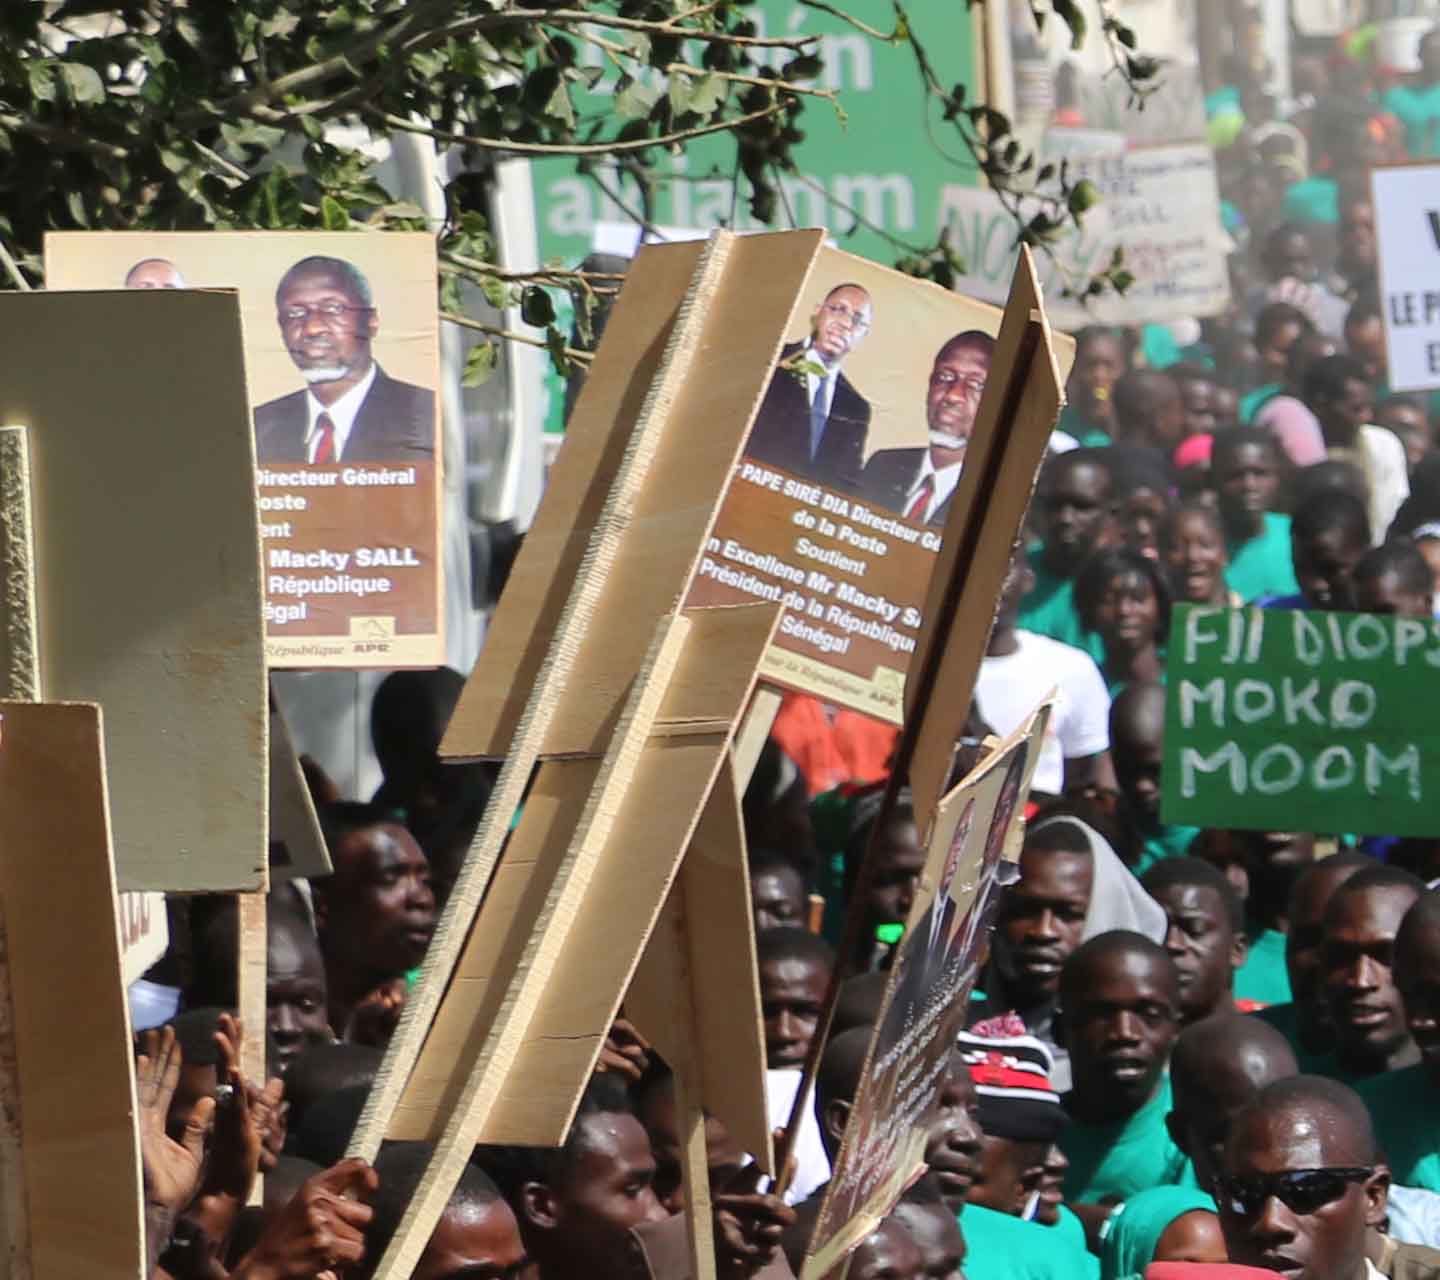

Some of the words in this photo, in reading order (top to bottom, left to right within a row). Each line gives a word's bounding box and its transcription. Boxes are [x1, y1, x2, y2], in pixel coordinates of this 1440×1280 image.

[1389, 294, 1421, 327] LE
[342, 468, 416, 486] Général
[740, 463, 784, 492] PAPE
[821, 493, 850, 518] DIA
[850, 503, 921, 544] Directeur
[793, 508, 816, 530] de
[818, 517, 837, 537] la
[837, 524, 888, 557] Poste
[269, 549, 350, 571] Macky
[355, 548, 420, 567] SALL
[795, 537, 868, 577] Soutient
[269, 575, 392, 597] République
[699, 558, 783, 603] Président
[783, 590, 807, 612] de
[807, 599, 826, 620] la
[826, 604, 917, 654] Républiqu
[807, 570, 837, 595] Mr
[836, 580, 902, 621] Macky
[779, 614, 851, 655] Sénégal
[1179, 676, 1378, 729] MOKO
[1179, 739, 1421, 802] MOOM
